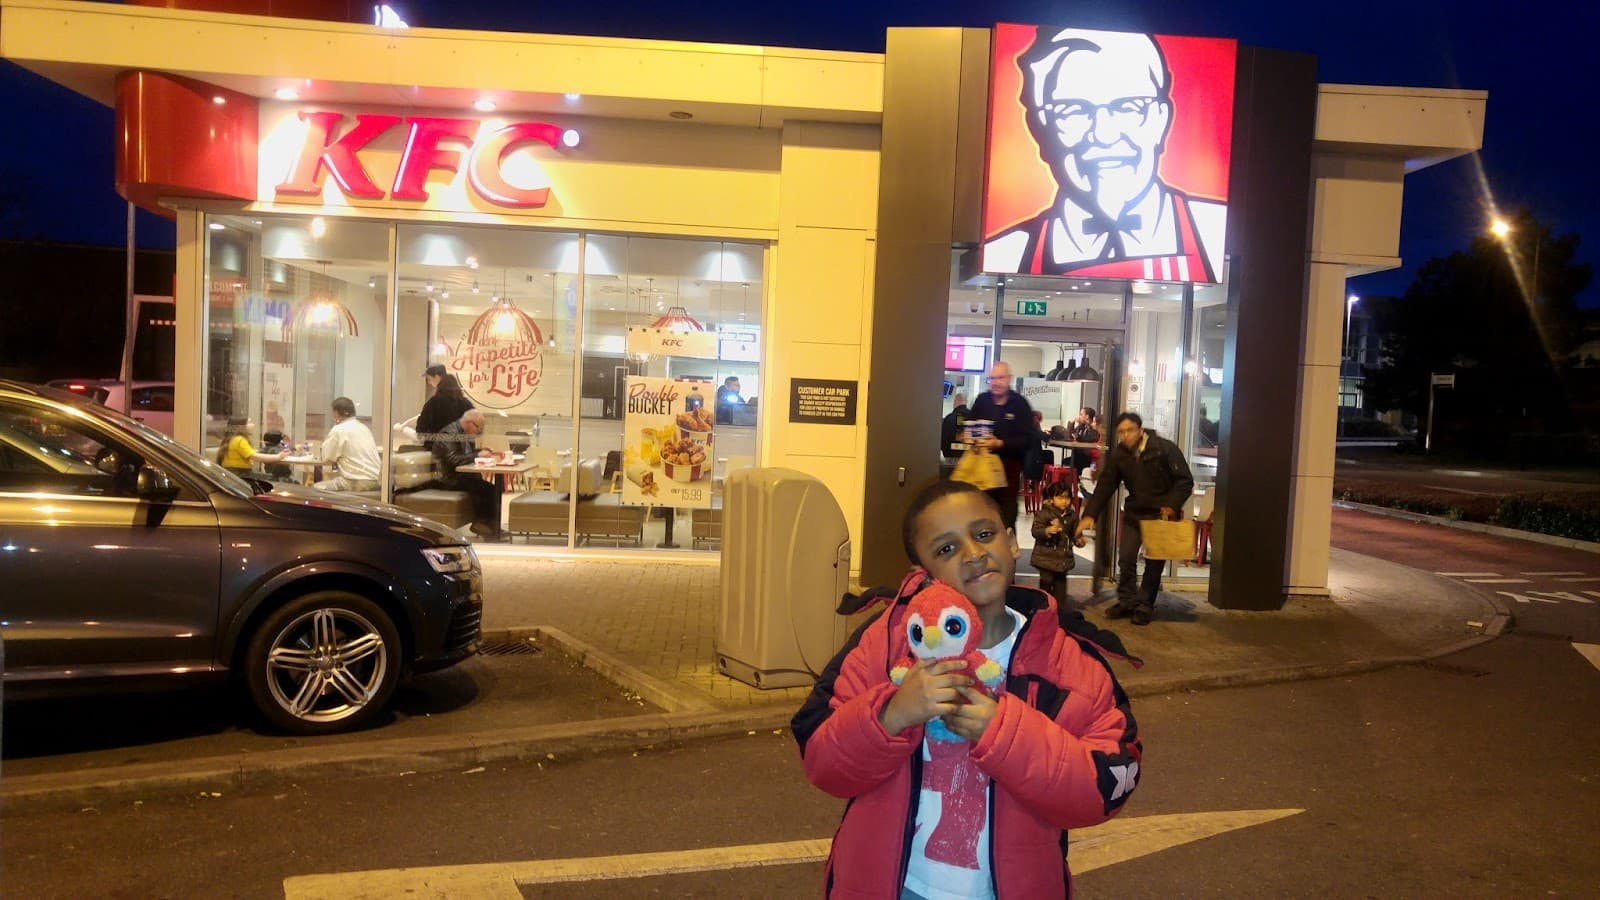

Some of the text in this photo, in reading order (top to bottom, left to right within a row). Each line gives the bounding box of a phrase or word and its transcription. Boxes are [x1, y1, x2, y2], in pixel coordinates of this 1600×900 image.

[275, 110, 562, 209] KFC
[662, 339, 684, 347] KFC
[452, 341, 538, 371] Appetite
[469, 364, 541, 398] for Life
[629, 383, 679, 402] Double
[798, 386, 850, 396] CUSTOMER CAR PARK
[628, 397, 673, 415] BUCKET
